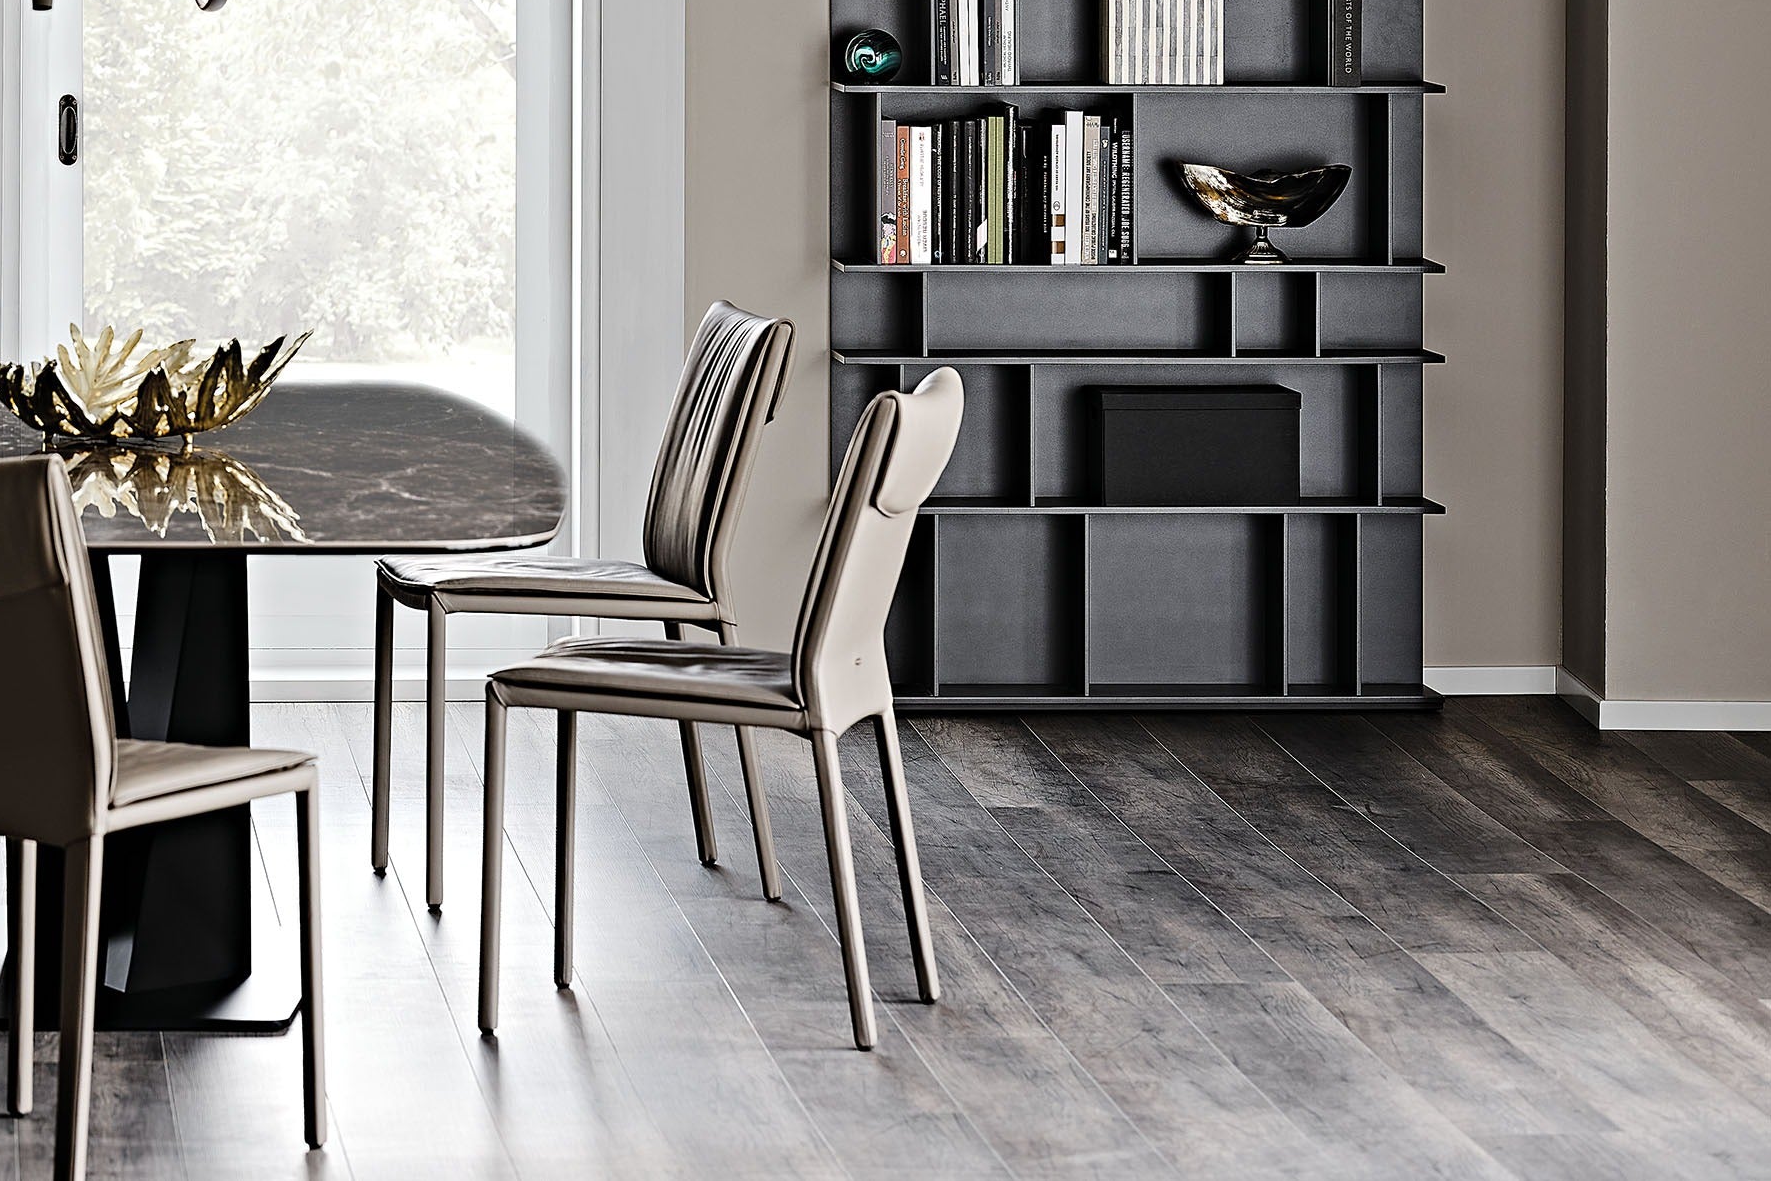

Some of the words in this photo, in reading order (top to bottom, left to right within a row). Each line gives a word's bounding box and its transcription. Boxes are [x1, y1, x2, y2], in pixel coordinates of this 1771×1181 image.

[1345, 13, 1353, 23] OF
[1345, 25, 1353, 41] THE
[1345, 42, 1353, 74] WORLD
[1121, 217, 1130, 228] JOE
[1121, 231, 1130, 247] SUGG
